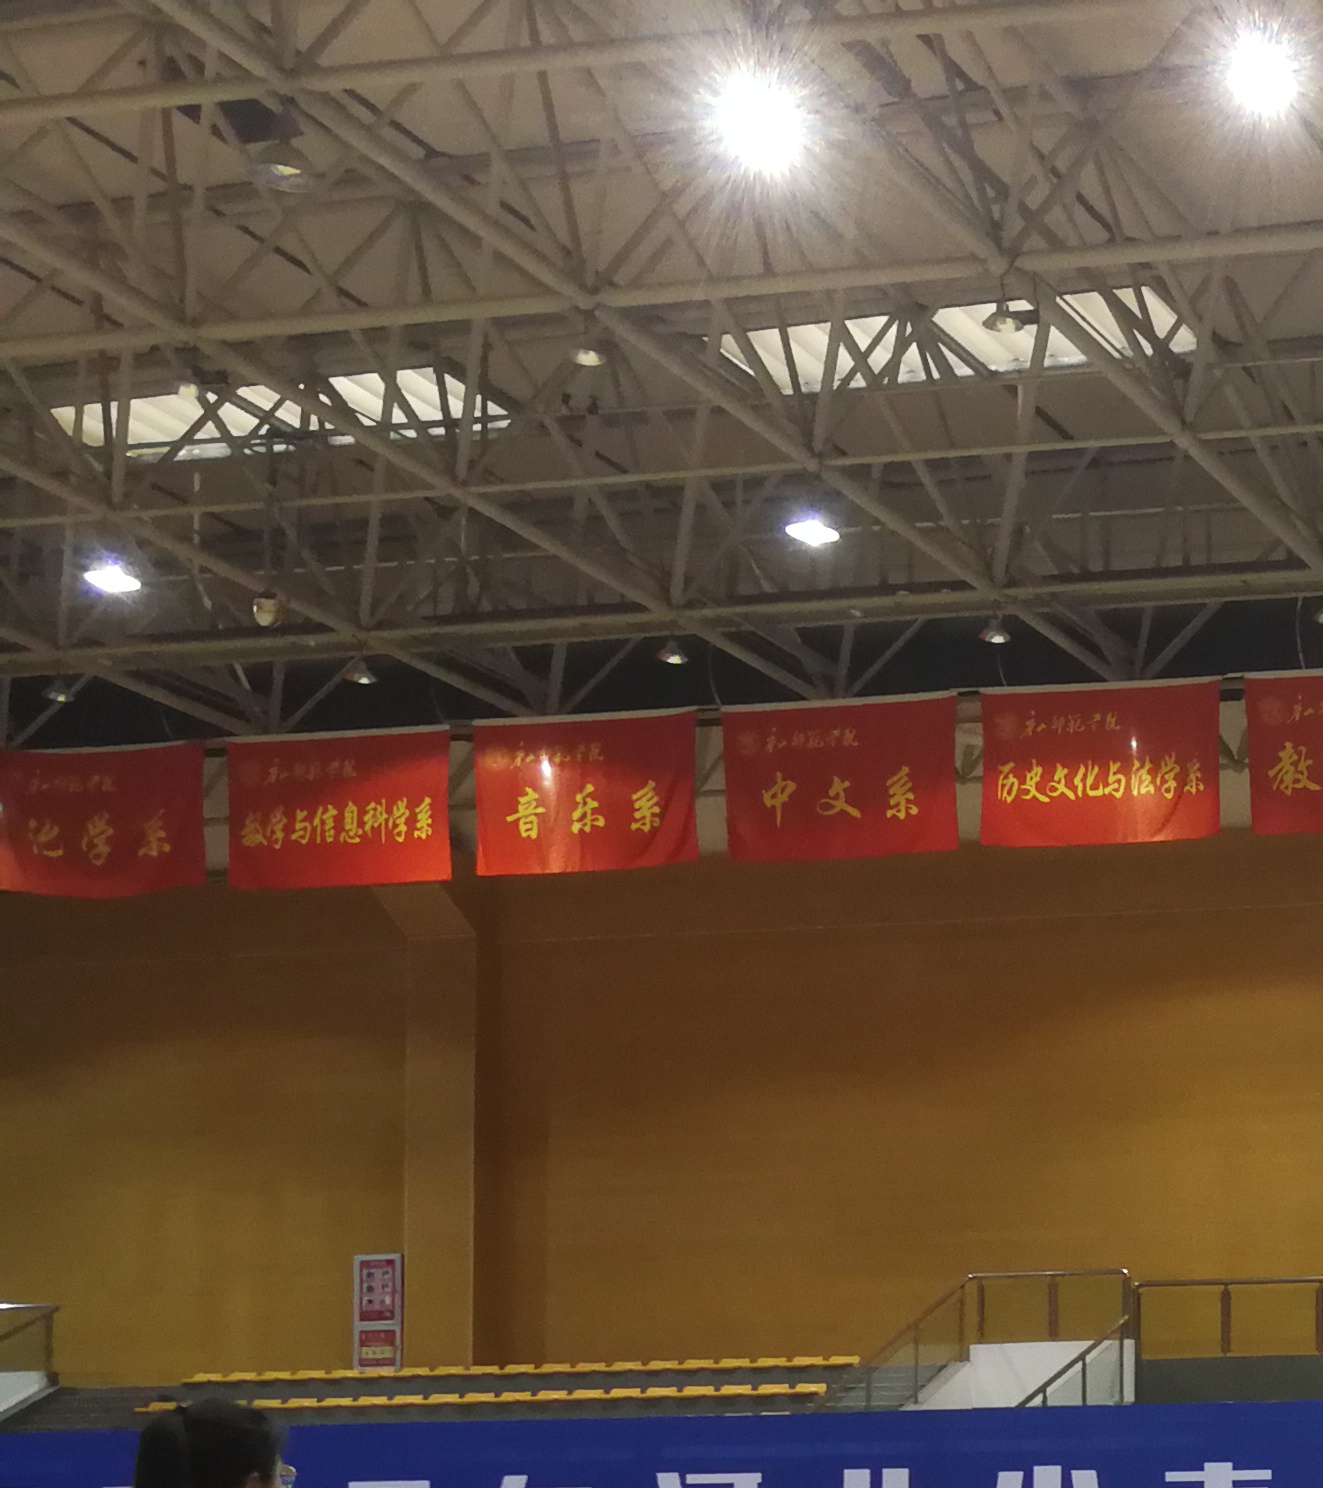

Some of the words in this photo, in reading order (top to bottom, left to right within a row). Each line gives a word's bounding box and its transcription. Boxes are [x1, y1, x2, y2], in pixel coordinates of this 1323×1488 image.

[762, 768, 920, 828] 中文系
[995, 753, 1206, 802] 历史文化与法学系
[241, 795, 434, 851] 数学与信息科学系
[504, 780, 668, 841] 音乐系
